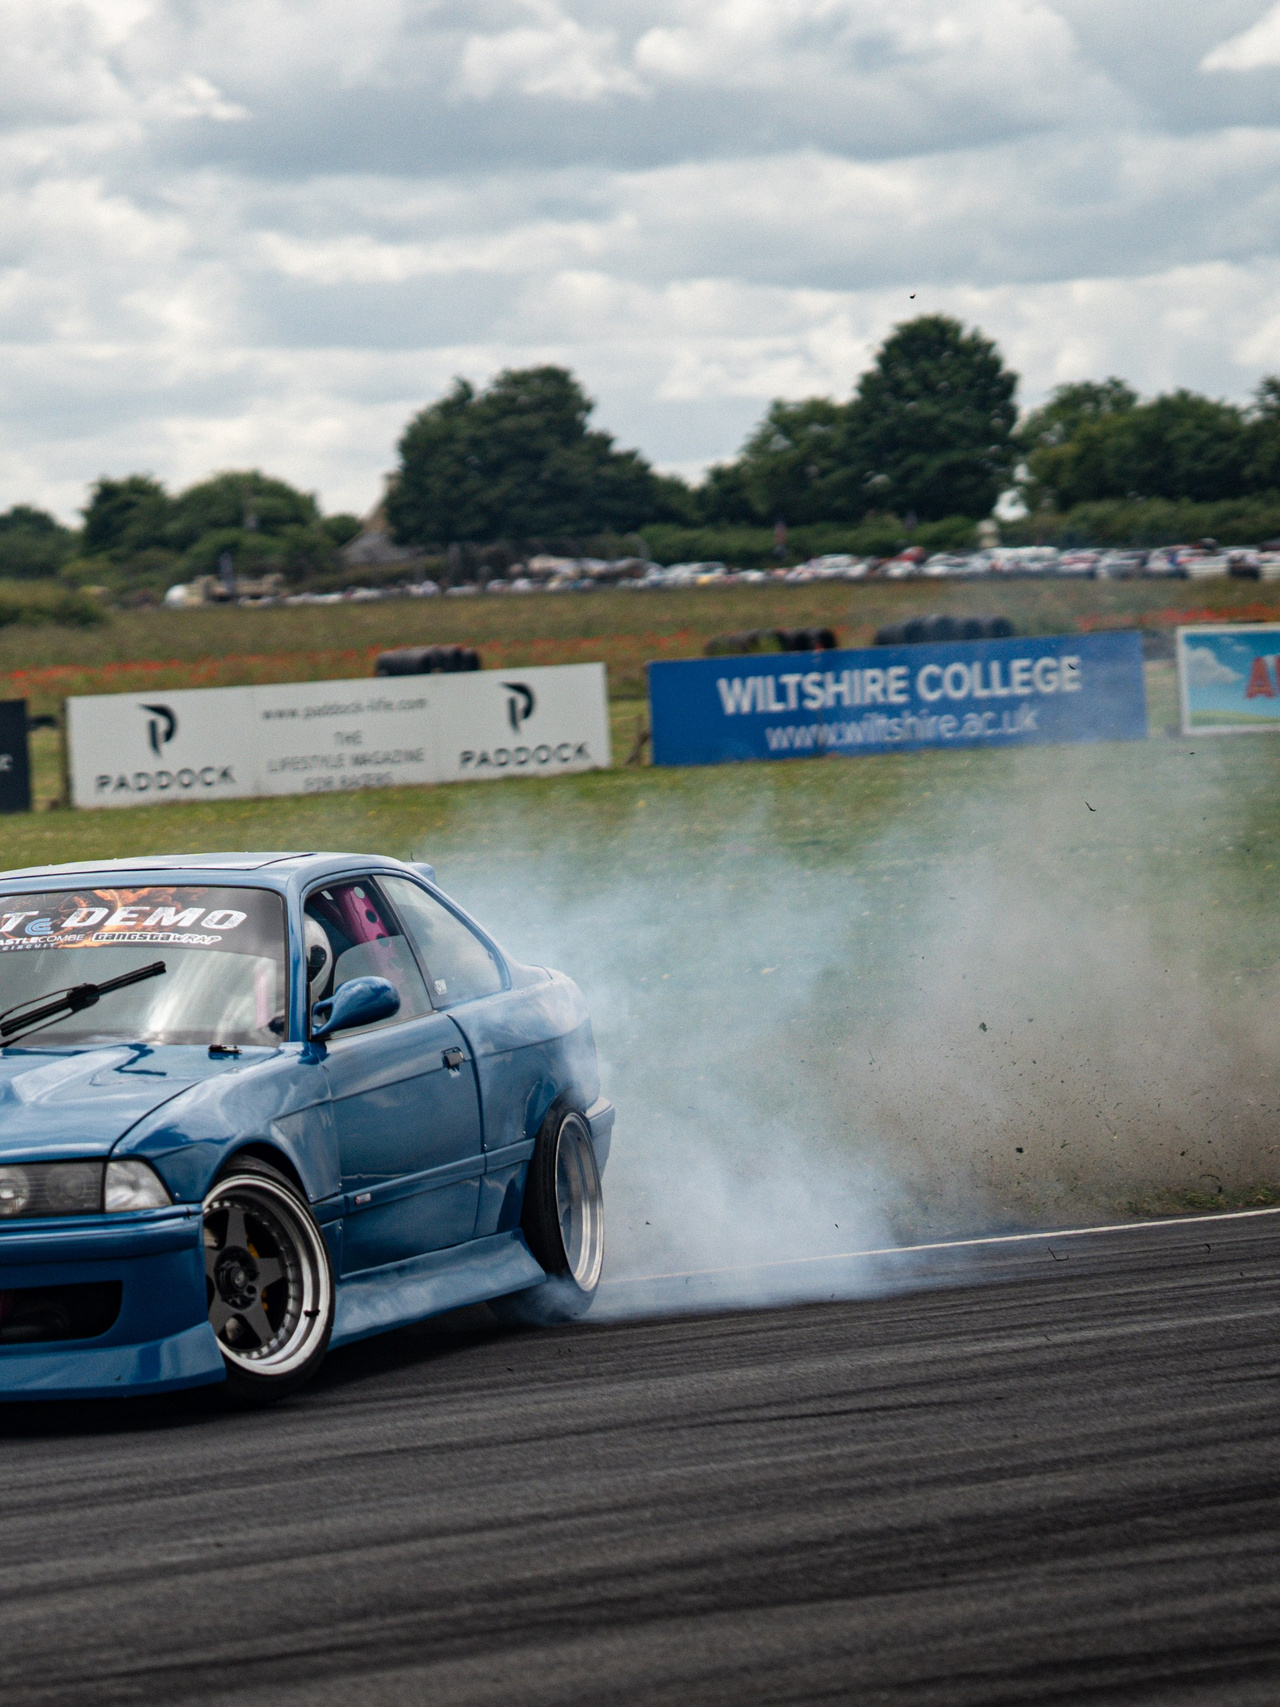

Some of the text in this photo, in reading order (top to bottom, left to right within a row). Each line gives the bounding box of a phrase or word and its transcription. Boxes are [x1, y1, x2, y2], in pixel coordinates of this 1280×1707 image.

[716, 655, 1083, 716] WILTSHIRE COLLEGE
[334, 729, 363, 746] THE
[765, 703, 1039, 751] www.wiltshire.ac.uk
[349, 748, 425, 767] MAGAZINE
[458, 741, 592, 771] PADDOCK
[94, 765, 236, 795] PADDOCK
[61, 907, 248, 930] DEMO
[2, 943, 57, 951] CIRCUIT
